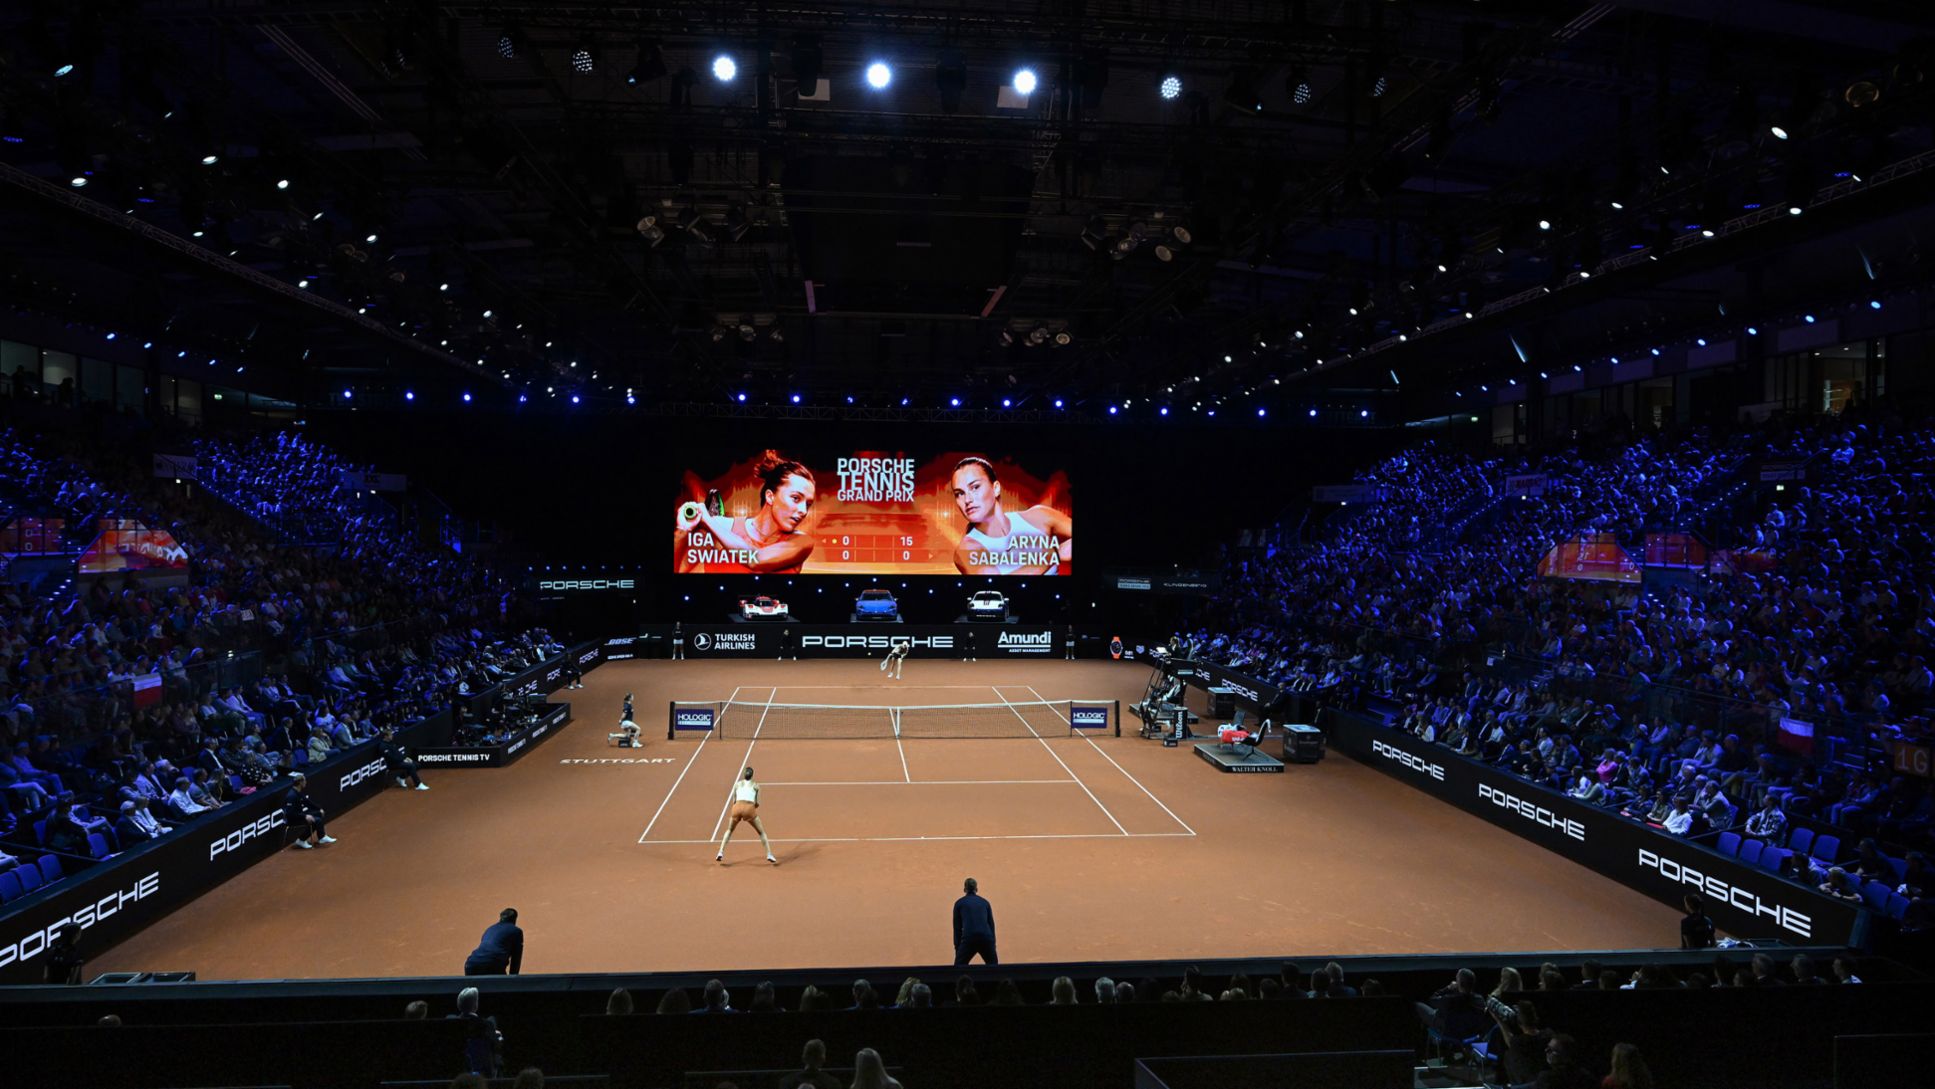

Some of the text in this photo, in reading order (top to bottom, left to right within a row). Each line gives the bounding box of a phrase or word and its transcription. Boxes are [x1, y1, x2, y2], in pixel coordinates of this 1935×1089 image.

[838, 458, 915, 473] PORSCHE
[837, 471, 915, 492] TENNIS
[838, 489, 915, 502] GRAND PRIX
[687, 532, 715, 547] IGA
[842, 535, 913, 547] 0 15
[1008, 536, 1060, 550] ARYNA
[687, 549, 759, 564] SWIATEK
[842, 550, 910, 561] 0 0
[969, 551, 1060, 567] SABALENKA
[540, 579, 635, 590] PORSCHE
[714, 633, 756, 642] TURKISH
[803, 635, 954, 648] PORSCHE
[998, 631, 1052, 644] Amundi
[714, 641, 756, 650] AIRLINES
[1222, 678, 1258, 702] PORSCHE
[677, 713, 712, 721] HOLOGIC
[1175, 711, 1183, 740] Wilson
[417, 753, 490, 763] PORSCHE TENNIS TV
[1372, 740, 1445, 782] PORSCHE
[340, 757, 387, 792] PORSC
[1478, 783, 1586, 842] PORSCHE
[210, 808, 285, 861] PORSC
[1638, 848, 1812, 938] PORSCHE
